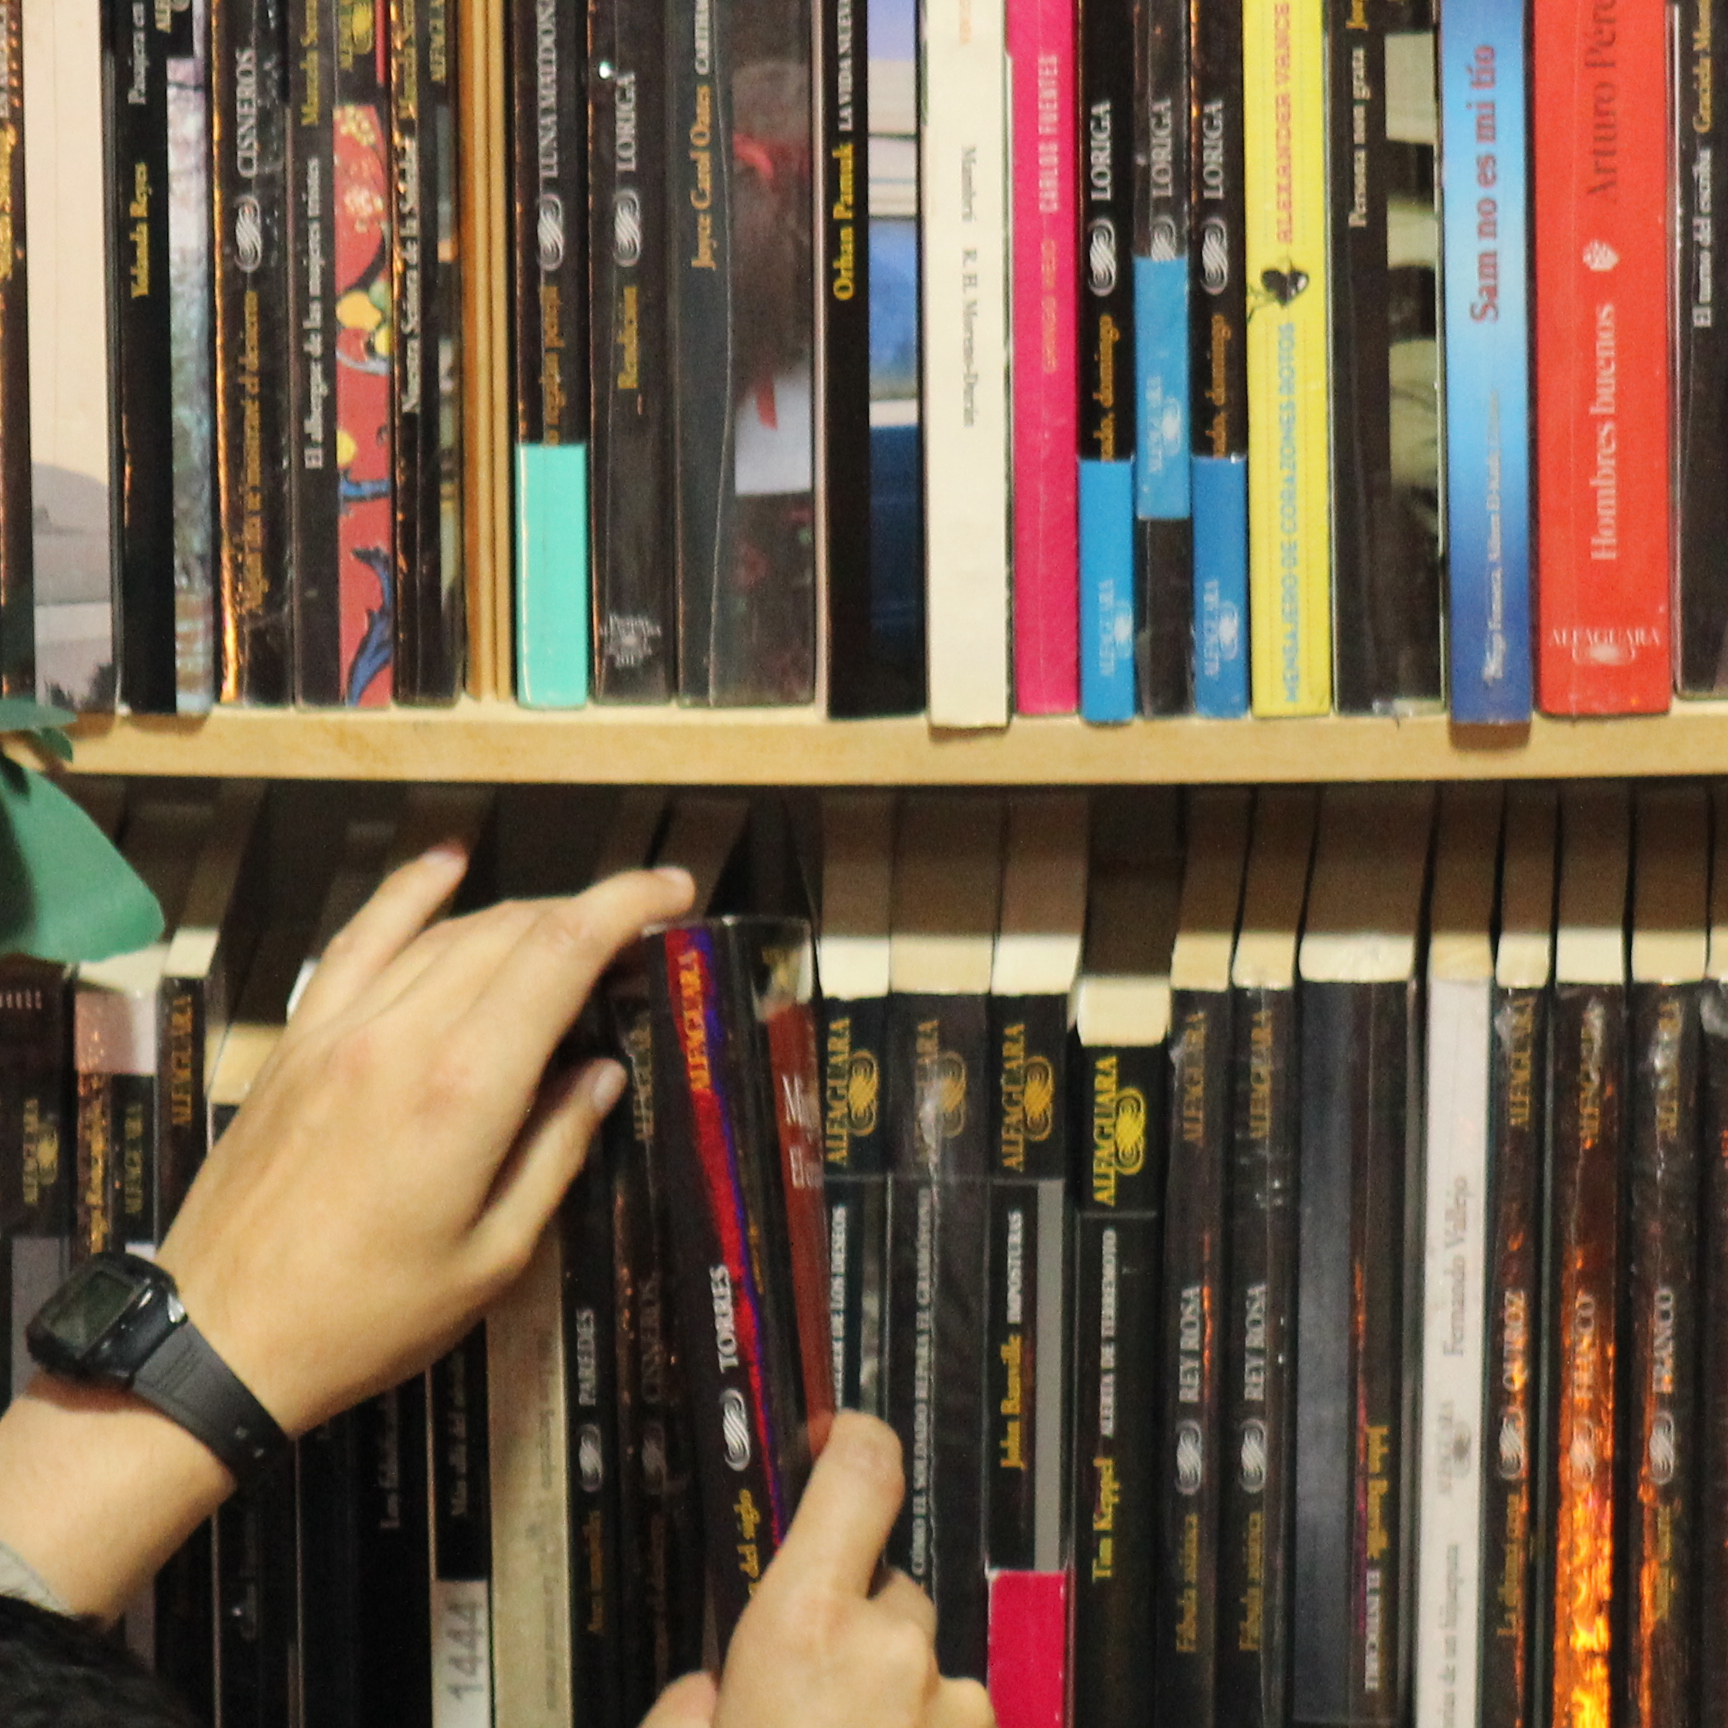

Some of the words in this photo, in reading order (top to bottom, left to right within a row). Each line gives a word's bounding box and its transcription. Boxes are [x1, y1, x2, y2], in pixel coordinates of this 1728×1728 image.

[1274, 5, 1291, 85] VANCE
[1467, 46, 1496, 90] tío
[236, 49, 256, 179] CISNEROS
[615, 70, 635, 170] LORIGA
[1038, 56, 1057, 134] FUENTES
[1468, 101, 1496, 142] mi
[834, 144, 855, 220] Pamuk
[1038, 144, 1057, 213] CARLOS
[1091, 103, 1111, 199] LORIGA
[1204, 101, 1224, 197] LORIGA
[1275, 94, 1292, 243] ALEXANDER
[1474, 155, 1496, 188] es
[834, 230, 855, 299] Orhan
[1474, 199, 1497, 239] no
[1471, 252, 1499, 322] Sam
[1278, 323, 1295, 394] ROTOS
[1590, 304, 1616, 413] buenos
[1279, 401, 1298, 533] CORAZONES
[1590, 422, 1618, 560] Hombres
[1279, 542, 1298, 568] DE
[1279, 574, 1299, 702] MENSAJERO
[675, 951, 710, 1095] ALFAGUARA
[827, 1019, 853, 1165] ALFAGUARA
[1001, 1023, 1028, 1172] ALFAGUARA
[1093, 1057, 1118, 1205] ALFAGUARA
[575, 1310, 595, 1405] PAREDES
[708, 1265, 738, 1372] TORRES
[1177, 1286, 1202, 1347] ROSA
[1652, 1288, 1676, 1394] FRANCO
[1177, 1352, 1202, 1402] REY
